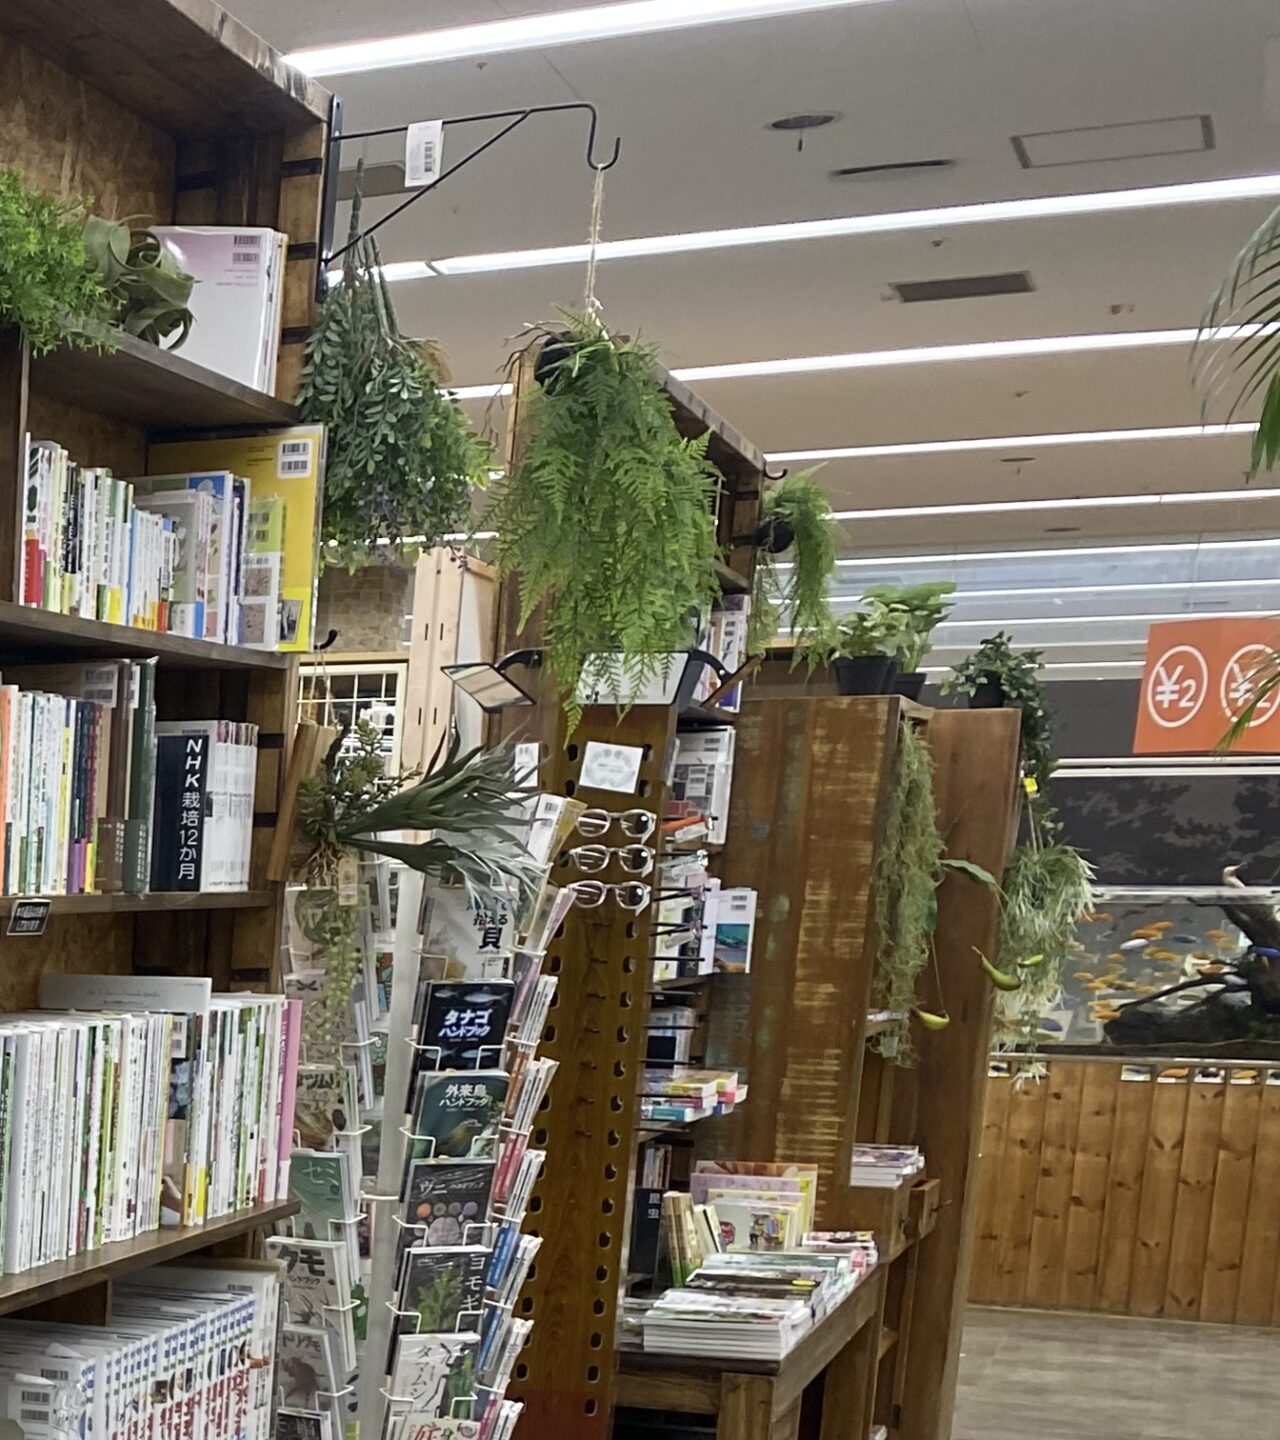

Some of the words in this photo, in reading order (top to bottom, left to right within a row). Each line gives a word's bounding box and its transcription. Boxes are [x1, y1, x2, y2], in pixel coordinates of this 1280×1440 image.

[177, 739, 203, 880] NHK栽培12か月
[439, 1024, 491, 1037] ハンドブック
[445, 1009, 492, 1024] タナゴ
[461, 1253, 486, 1312] ヨモギ
